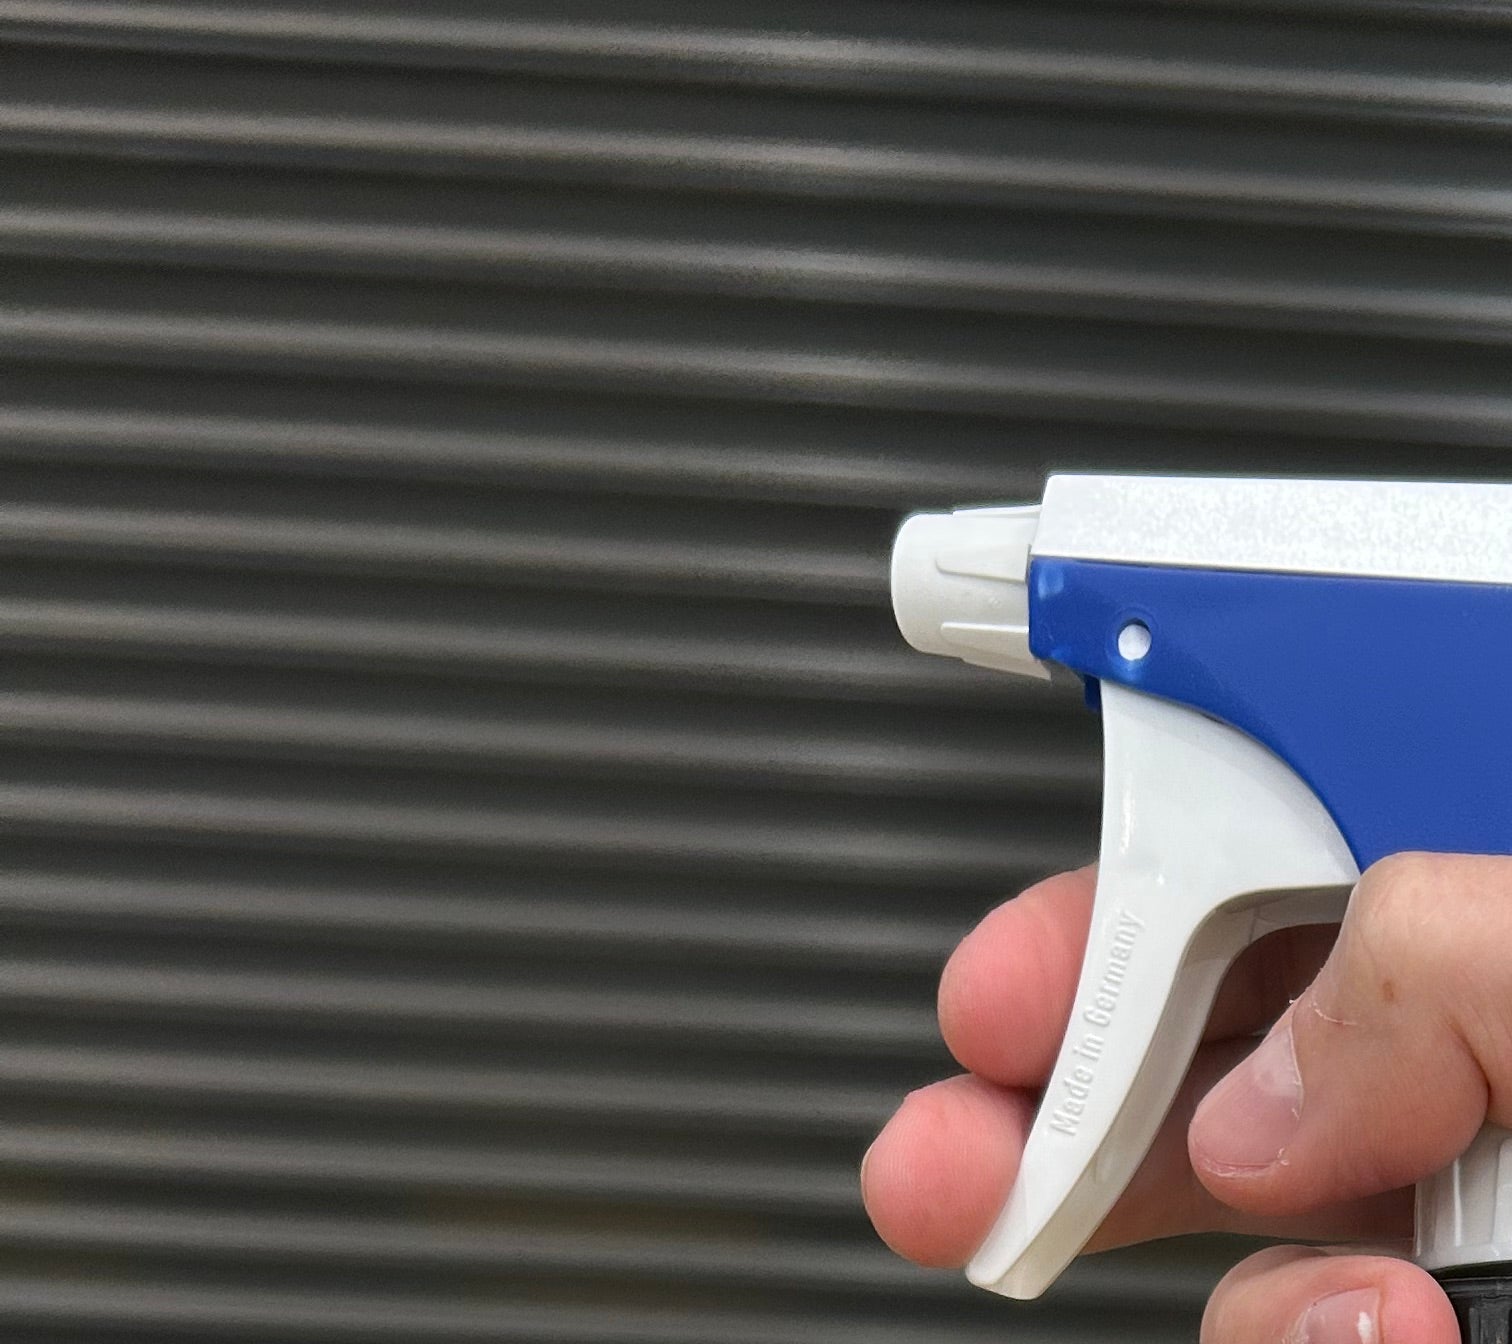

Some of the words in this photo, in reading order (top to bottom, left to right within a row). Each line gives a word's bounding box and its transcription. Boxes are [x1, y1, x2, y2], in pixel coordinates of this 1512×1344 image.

[1083, 909, 1145, 1028] Germany
[1073, 1031, 1105, 1063] in
[1050, 1066, 1095, 1137] Made
